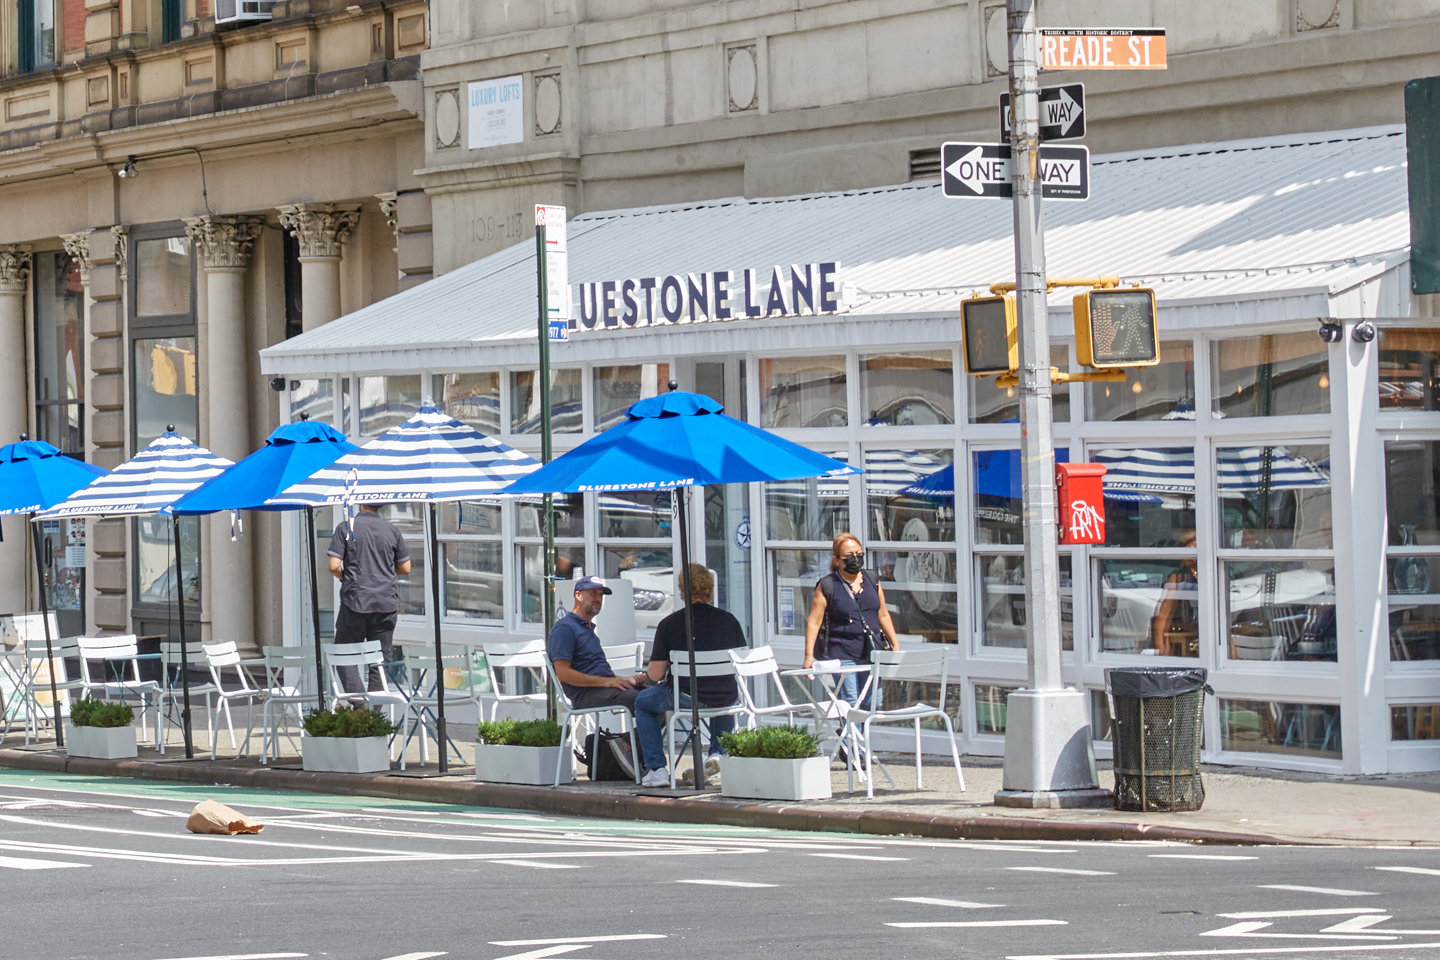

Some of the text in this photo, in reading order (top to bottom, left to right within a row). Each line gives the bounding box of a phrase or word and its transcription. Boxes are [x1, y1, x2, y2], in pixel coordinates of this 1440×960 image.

[1044, 36, 1152, 67] READE ST
[471, 82, 520, 107] LUXURY LOFTS
[1048, 100, 1074, 124] WAY
[959, 160, 1005, 181] ONE
[743, 261, 841, 319] LANE
[578, 478, 694, 492] BLUESTONE LANE
[397, 492, 428, 500] LANE
[14, 504, 41, 514] LANE
[58, 503, 138, 514] BLUESTONE LANE
